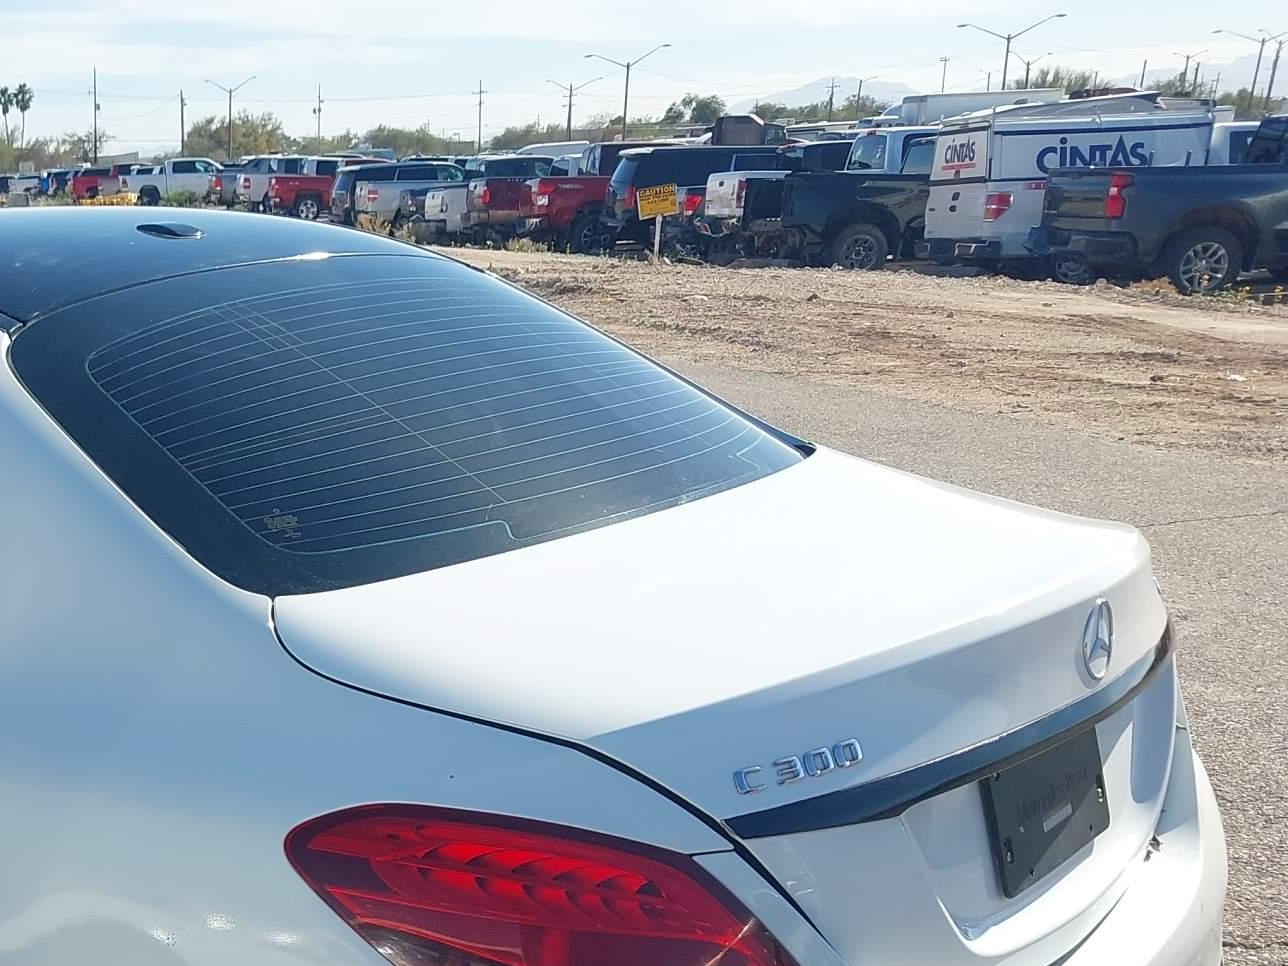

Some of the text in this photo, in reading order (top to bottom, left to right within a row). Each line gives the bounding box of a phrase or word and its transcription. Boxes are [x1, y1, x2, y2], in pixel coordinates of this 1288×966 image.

[639, 185, 675, 197] CAUTION
[733, 738, 863, 794] C 300
